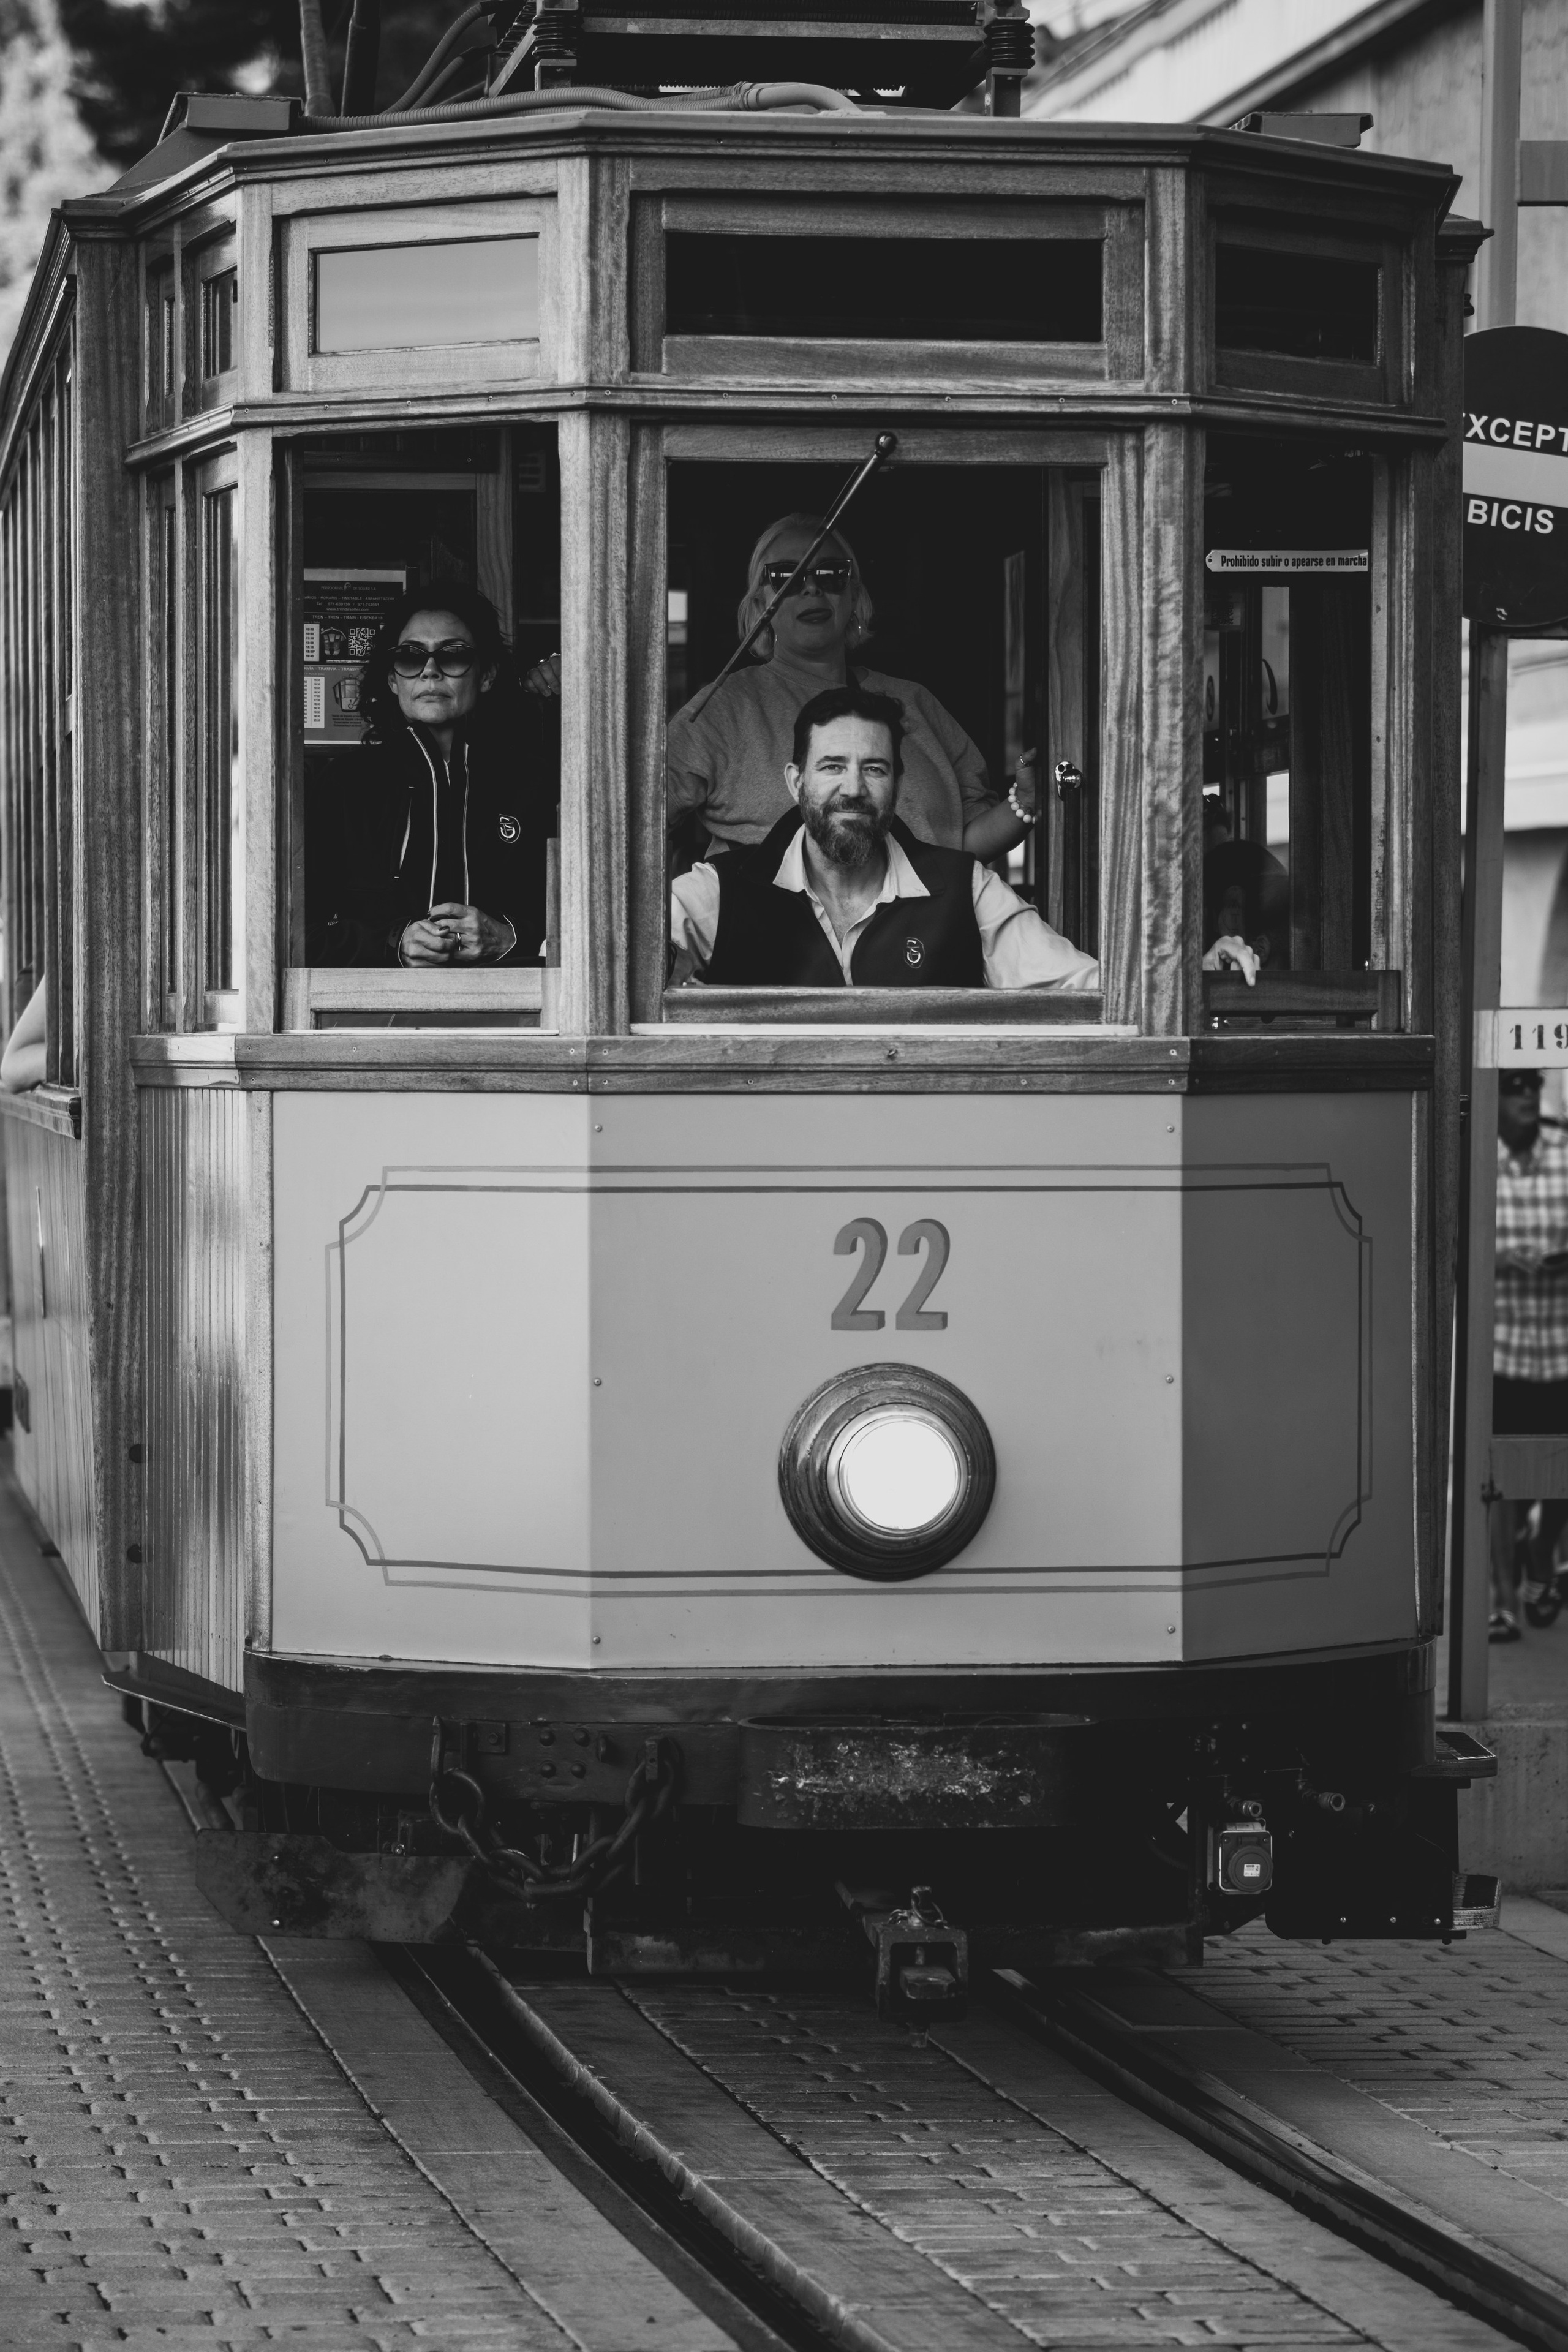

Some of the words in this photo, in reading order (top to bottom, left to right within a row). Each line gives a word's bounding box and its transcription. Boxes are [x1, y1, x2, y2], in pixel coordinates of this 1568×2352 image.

[1462, 412, 1568, 453] XCEPT
[1467, 499, 1554, 534] BICIS
[1221, 554, 1259, 567] Prohibido
[1261, 555, 1283, 567] subir
[1284, 557, 1289, 567] o
[1291, 557, 1324, 569] apearse
[1325, 557, 1335, 567] en
[1338, 555, 1367, 567] marcha
[1509, 1023, 1568, 1050] 119
[831, 1216, 951, 1331] 22
